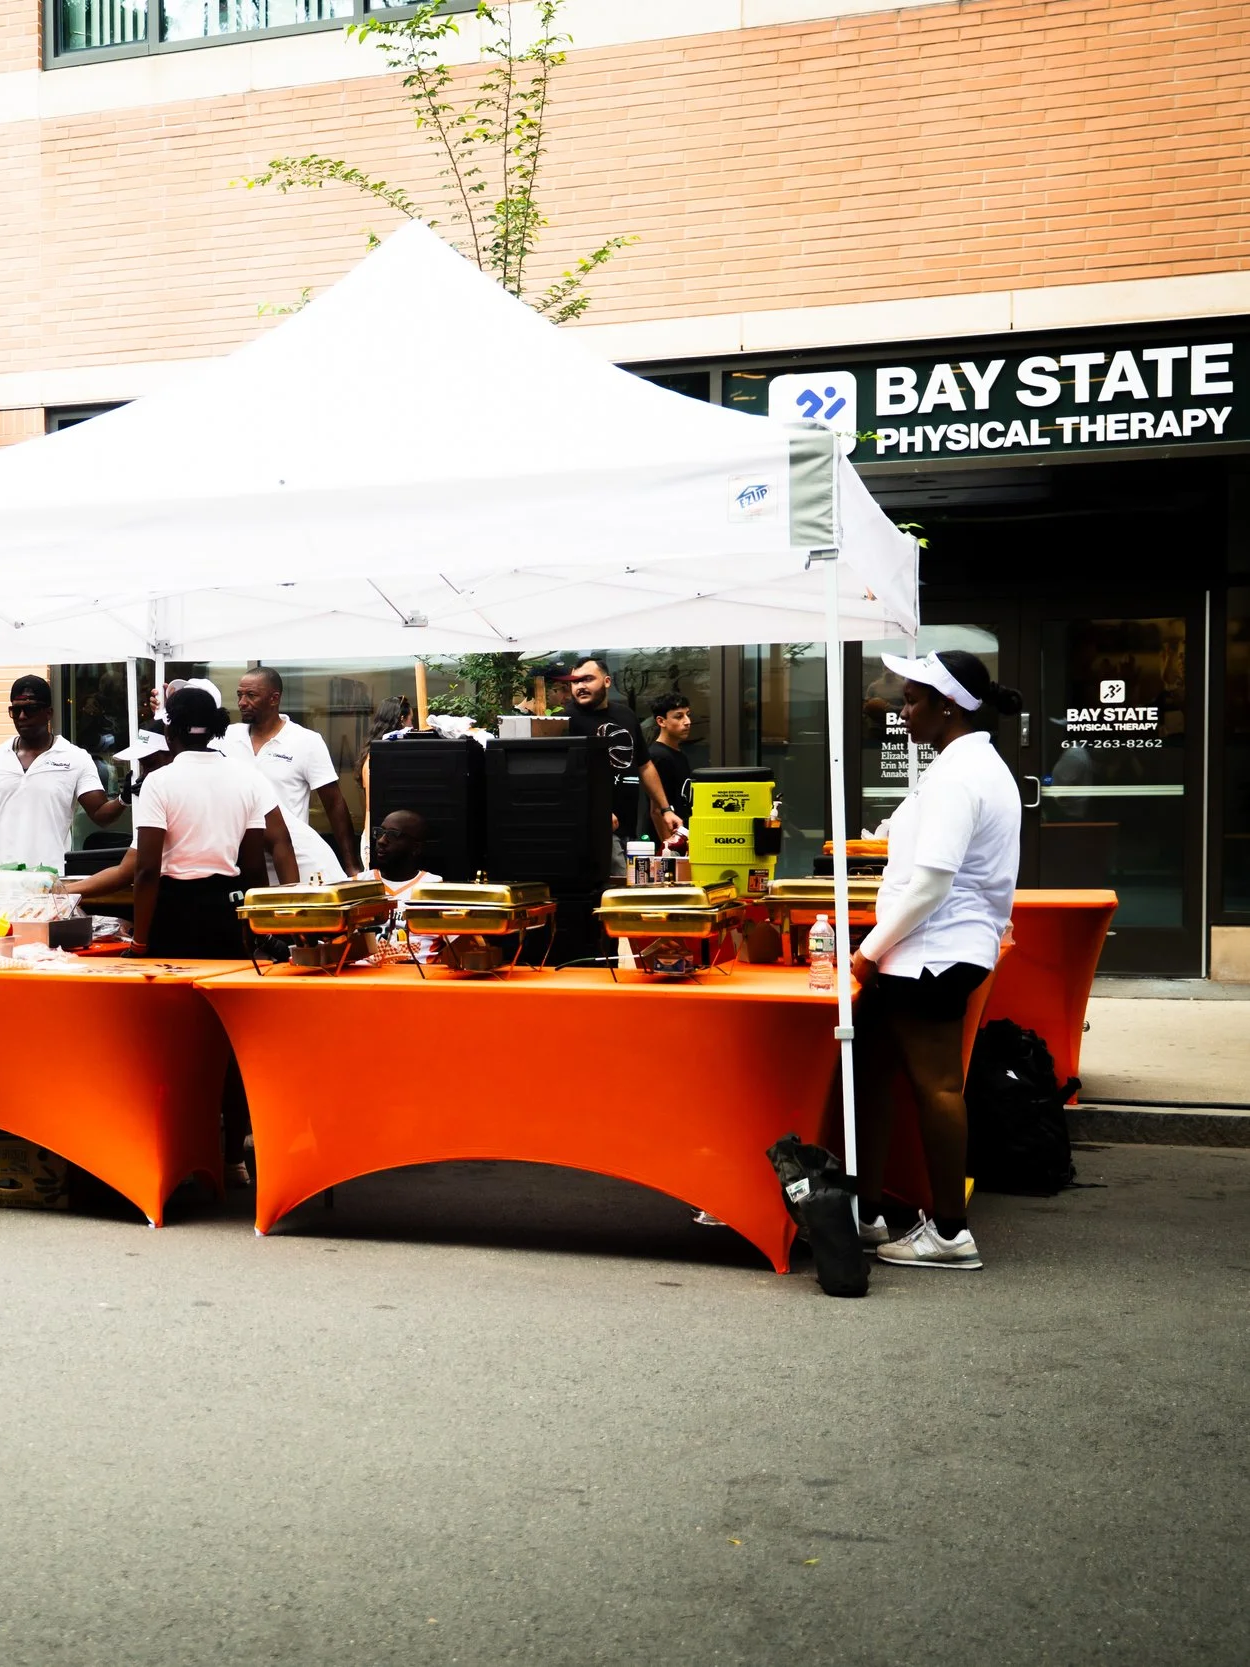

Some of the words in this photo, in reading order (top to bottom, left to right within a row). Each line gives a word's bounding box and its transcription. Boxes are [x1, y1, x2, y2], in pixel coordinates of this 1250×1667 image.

[875, 359, 1006, 417] BAY
[1016, 343, 1234, 408] STATE
[876, 418, 1051, 454] PHYSICAL
[1055, 406, 1233, 445] THERAPY
[885, 712, 906, 725] BA
[1066, 708, 1101, 722] BAY
[1103, 707, 1158, 721] STATE
[1067, 723, 1112, 731] PHYSICAL
[1113, 723, 1158, 731] THERAPY
[881, 742, 904, 751] Matt
[1061, 739, 1163, 749] 617-263-8262
[881, 751, 910, 760] Elizabe
[880, 761, 897, 770] Erin
